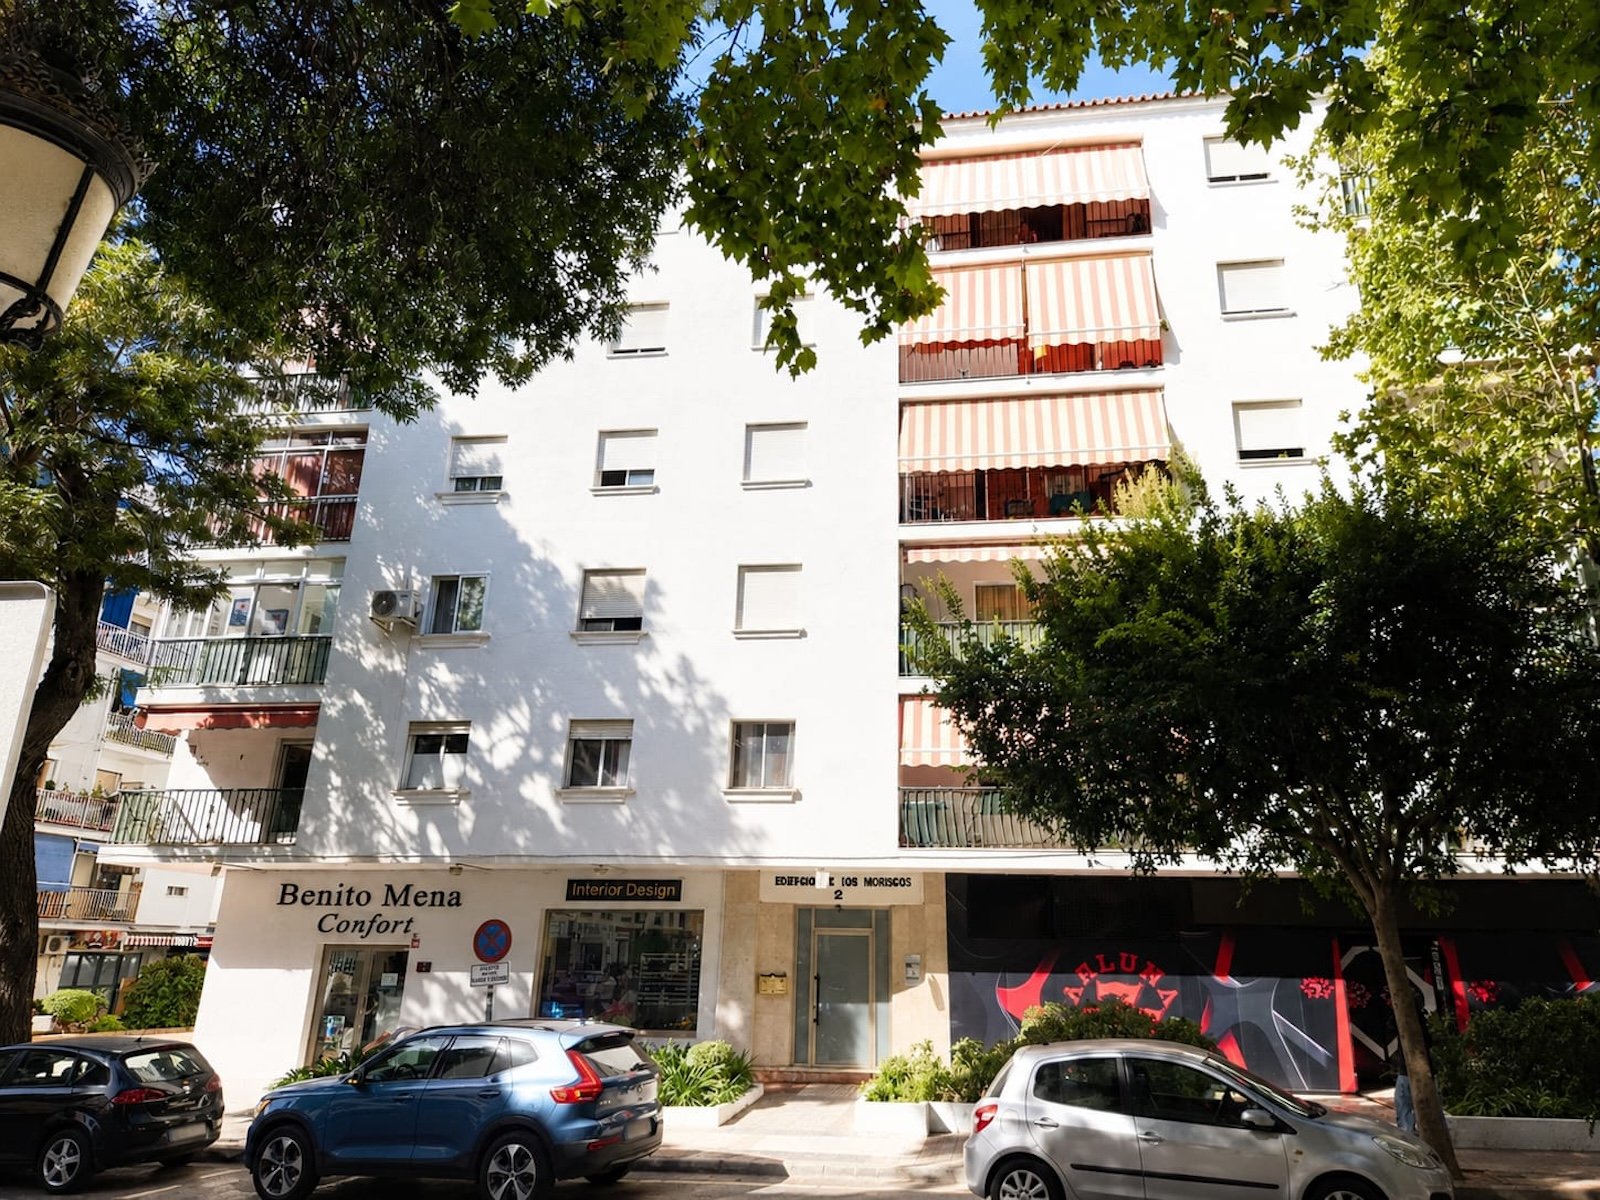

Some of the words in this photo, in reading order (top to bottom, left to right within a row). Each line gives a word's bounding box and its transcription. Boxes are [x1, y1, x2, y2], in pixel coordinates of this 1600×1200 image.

[863, 877, 912, 887] MORISCOS
[277, 883, 371, 907] Benito
[381, 884, 462, 907] Mena
[572, 883, 622, 896] Interior
[626, 883, 676, 899] Design
[834, 889, 843, 900] 2
[317, 913, 415, 938] Confort
